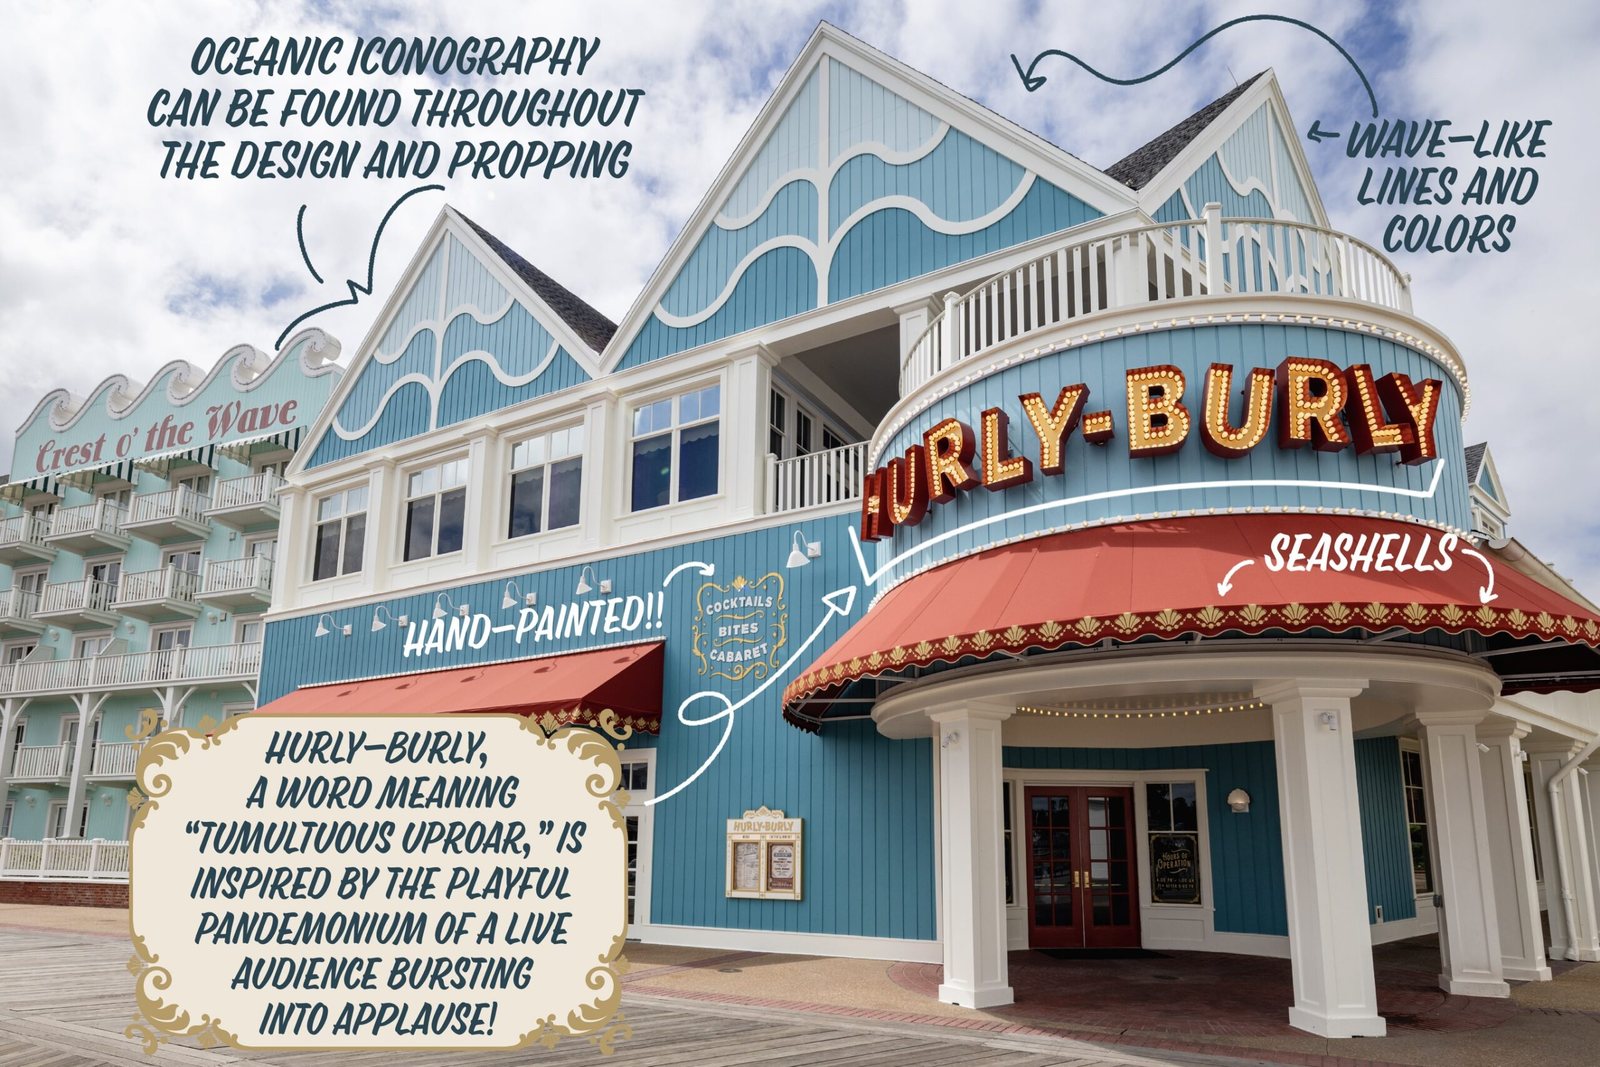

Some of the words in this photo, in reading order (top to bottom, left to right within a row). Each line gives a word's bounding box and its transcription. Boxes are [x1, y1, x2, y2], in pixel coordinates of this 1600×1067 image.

[35, 432, 106, 473] Crest
[144, 413, 193, 452] the
[206, 399, 298, 440] Wave
[861, 356, 1443, 542] HURLY-BURLY
[706, 595, 773, 615] COCKTAILS
[718, 622, 759, 637] BITES
[709, 642, 769, 663] CABARET
[733, 821, 794, 832] HURLY-BURLY
